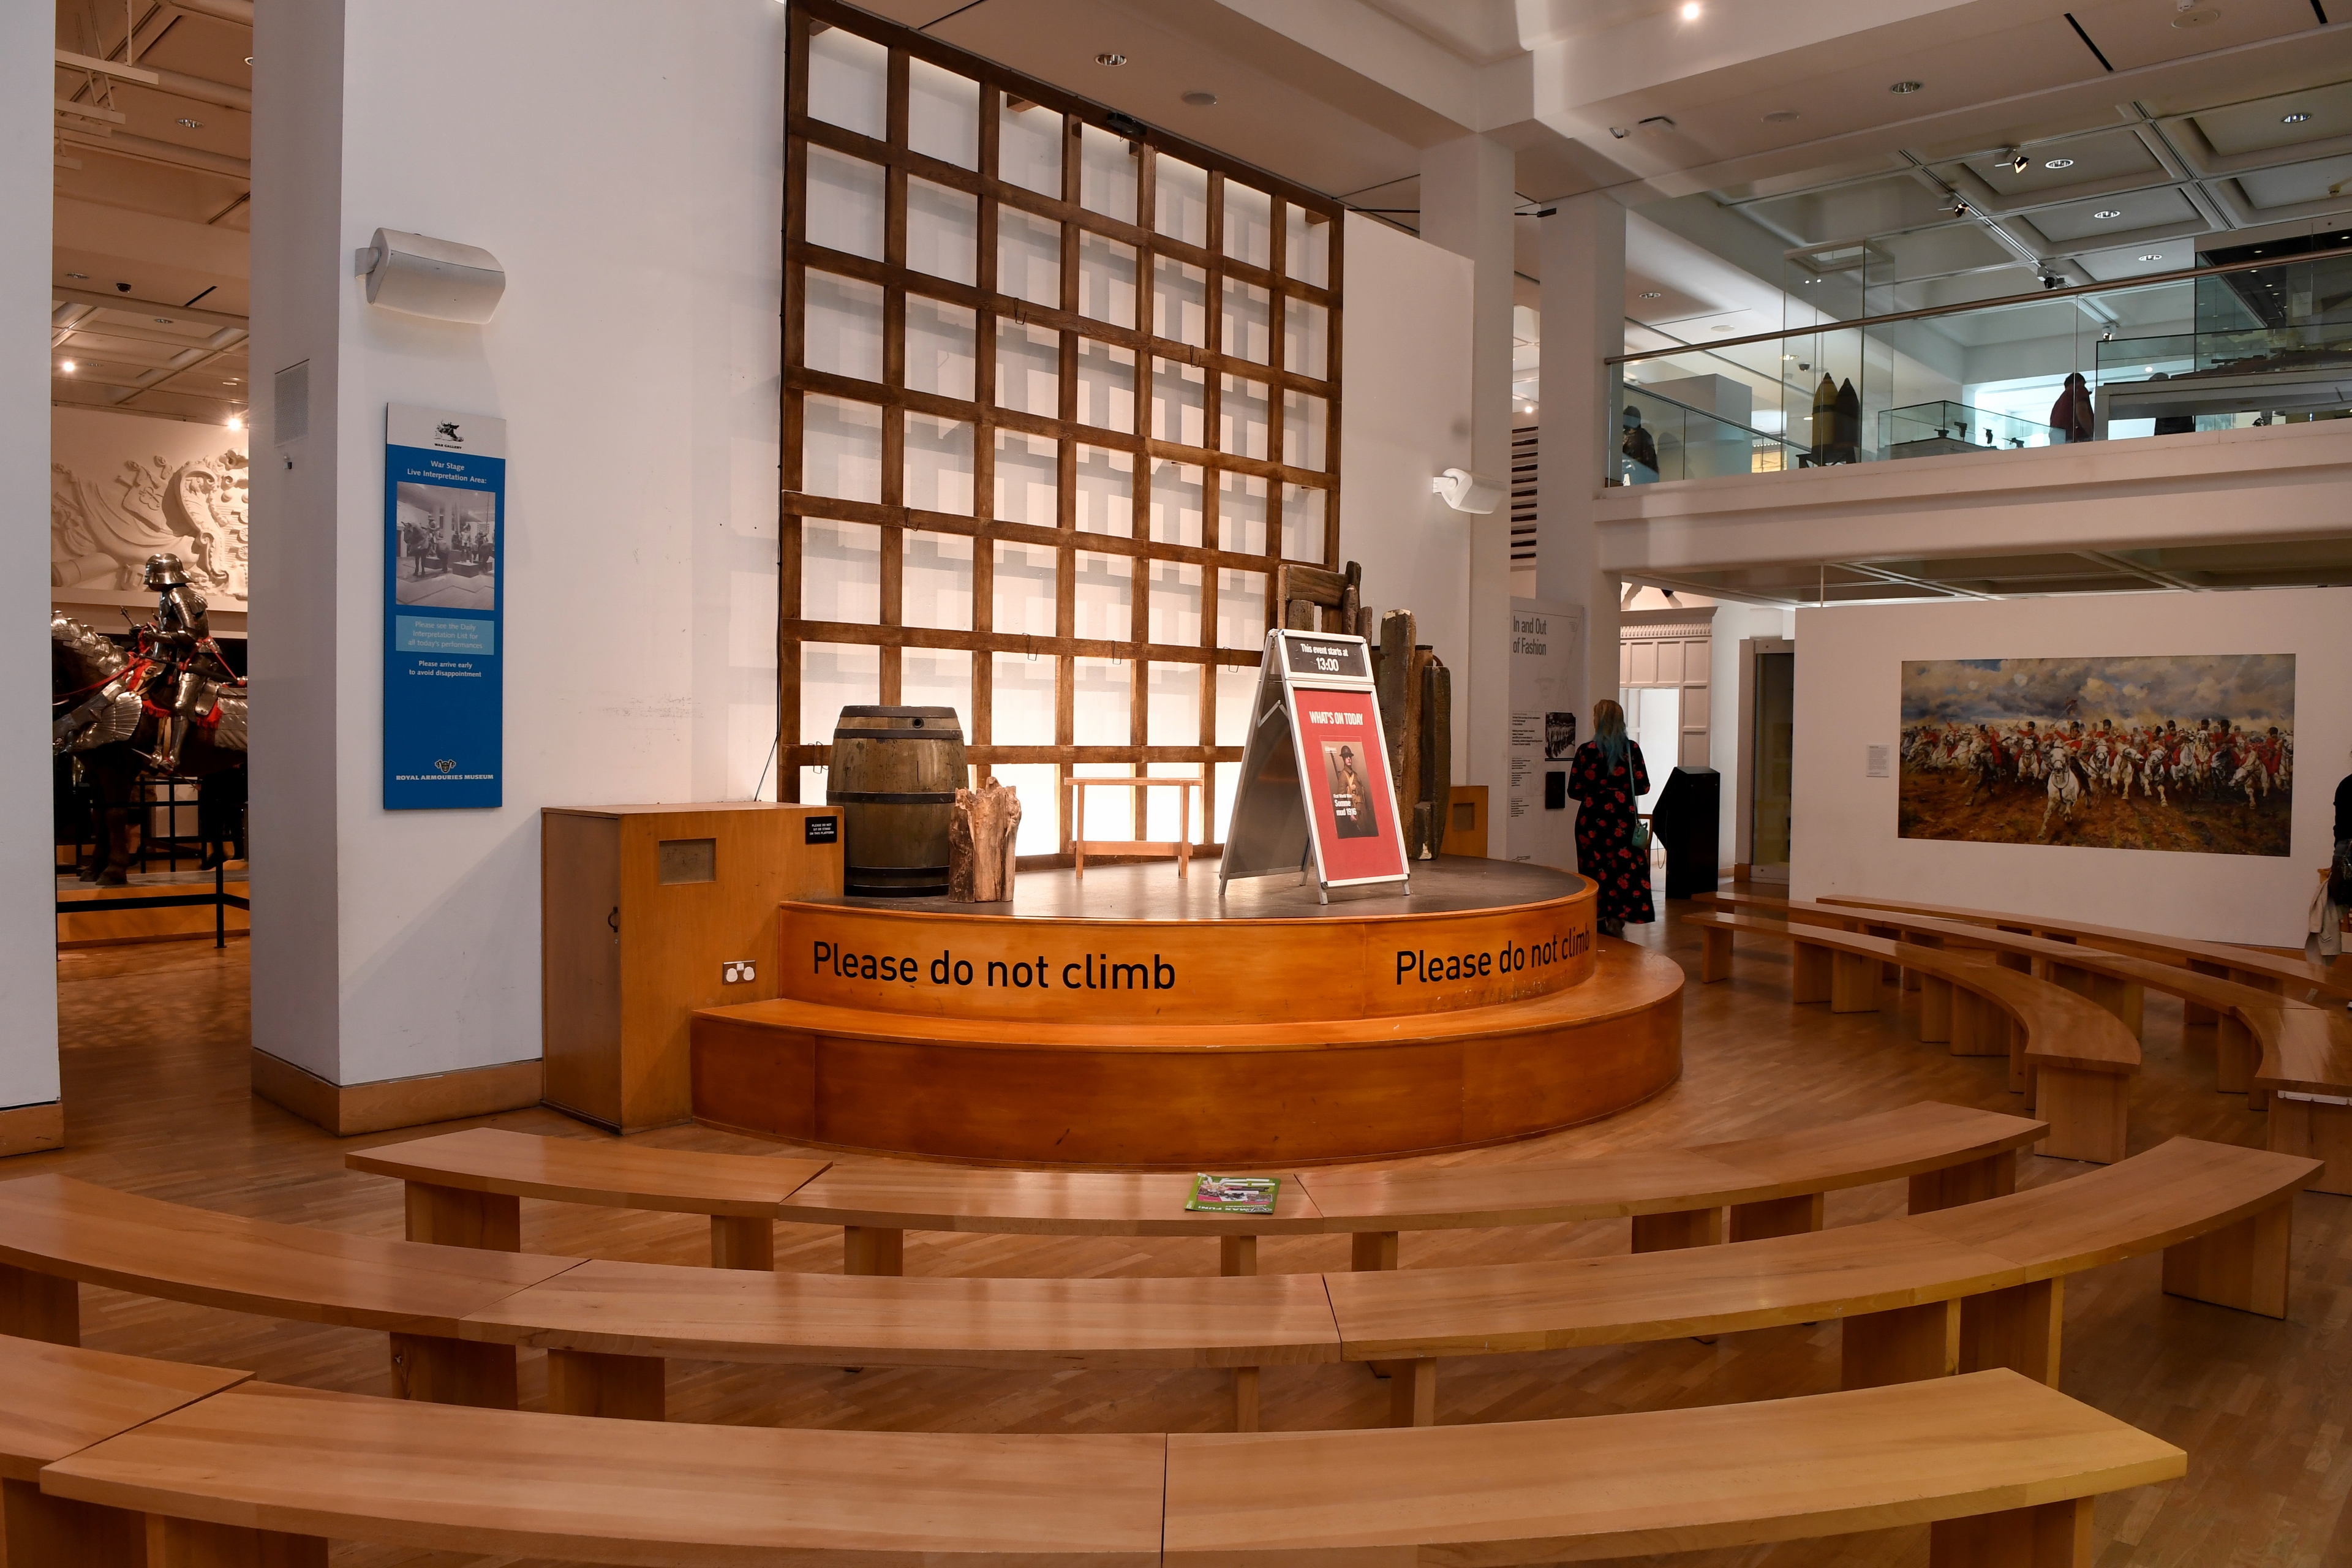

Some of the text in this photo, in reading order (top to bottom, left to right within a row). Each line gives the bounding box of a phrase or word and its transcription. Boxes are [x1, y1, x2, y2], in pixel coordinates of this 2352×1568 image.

[447, 462, 465, 472] Stage
[423, 470, 468, 481] Interpretation
[1513, 615, 1547, 635] In and Out
[413, 630, 455, 639] Interpretation
[441, 641, 483, 649] performances
[1300, 643, 1349, 657] This event starts at
[1513, 637, 1547, 656] of Fashion
[1316, 657, 1340, 671] 13:00
[1309, 710, 1363, 726] WHAT'S ON TODAY
[1396, 922, 1589, 986] Please do not climb
[813, 940, 1175, 990] Please do not climb
